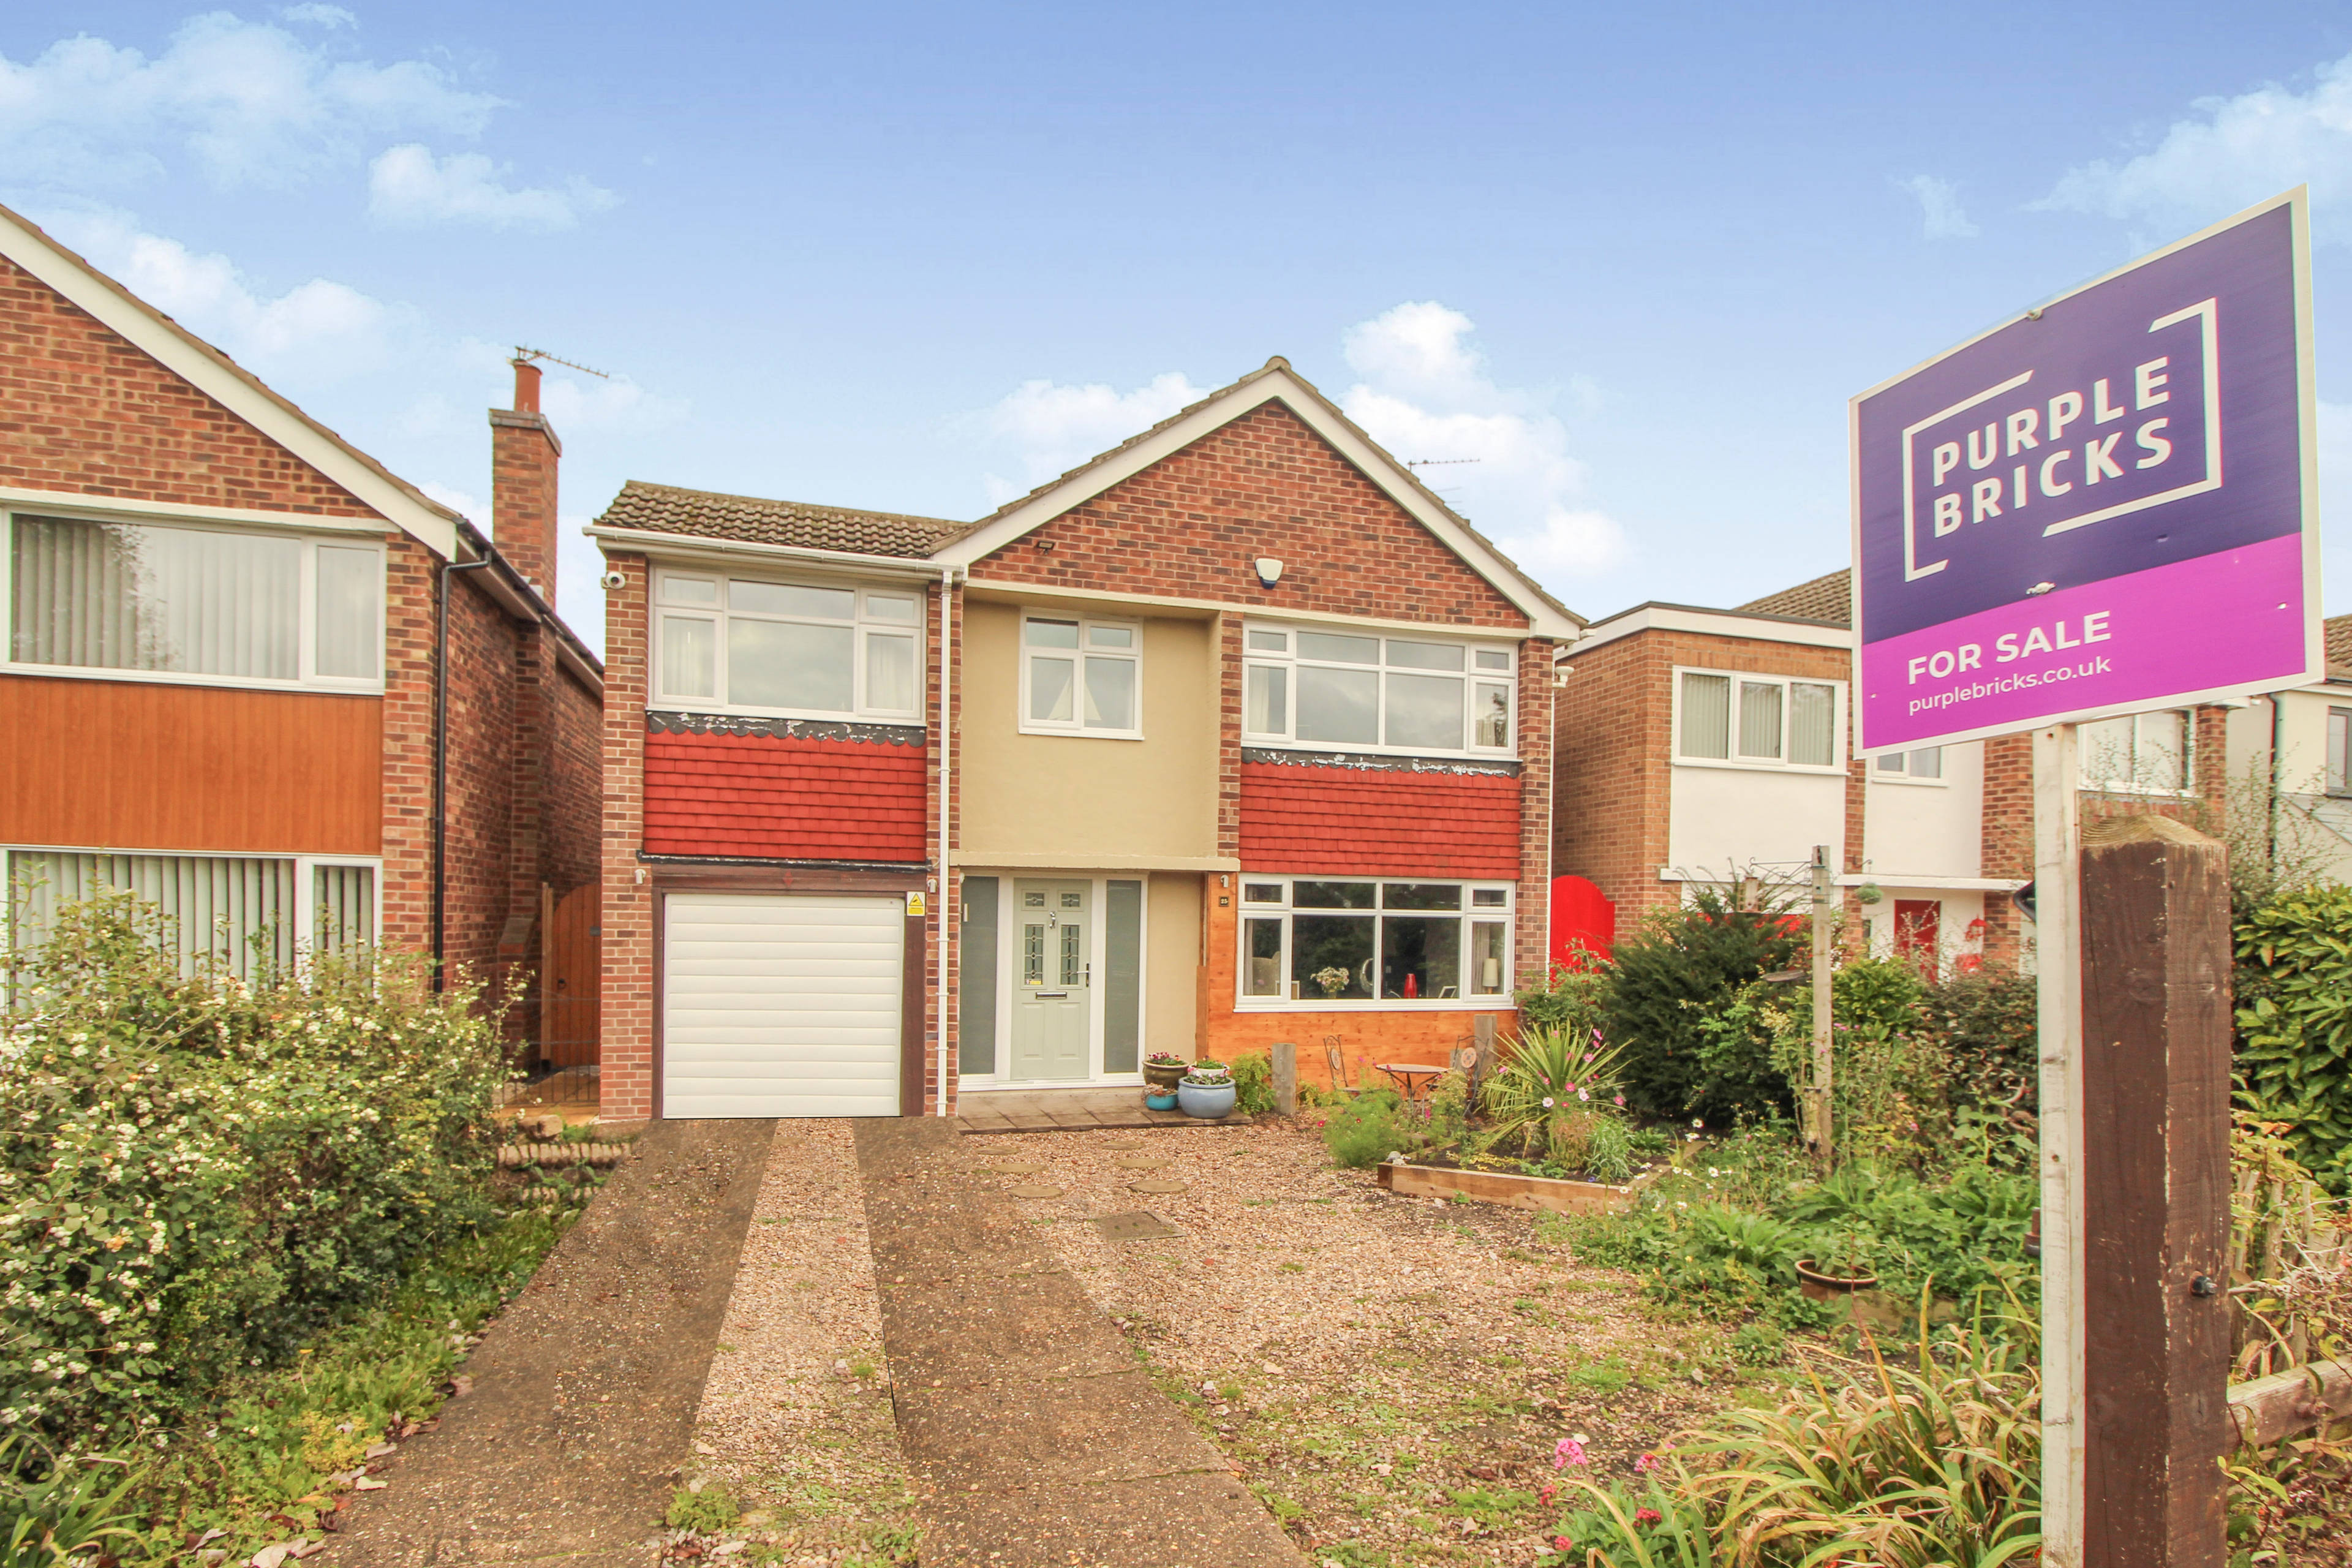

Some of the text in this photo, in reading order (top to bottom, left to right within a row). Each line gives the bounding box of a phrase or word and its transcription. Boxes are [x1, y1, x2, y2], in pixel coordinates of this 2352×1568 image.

[1933, 357, 2170, 486] PURPLE
[1934, 418, 2172, 538] BRICKS
[1908, 611, 2111, 685] FOR SALE
[1909, 656, 2111, 716] purplebricks.co.uk
